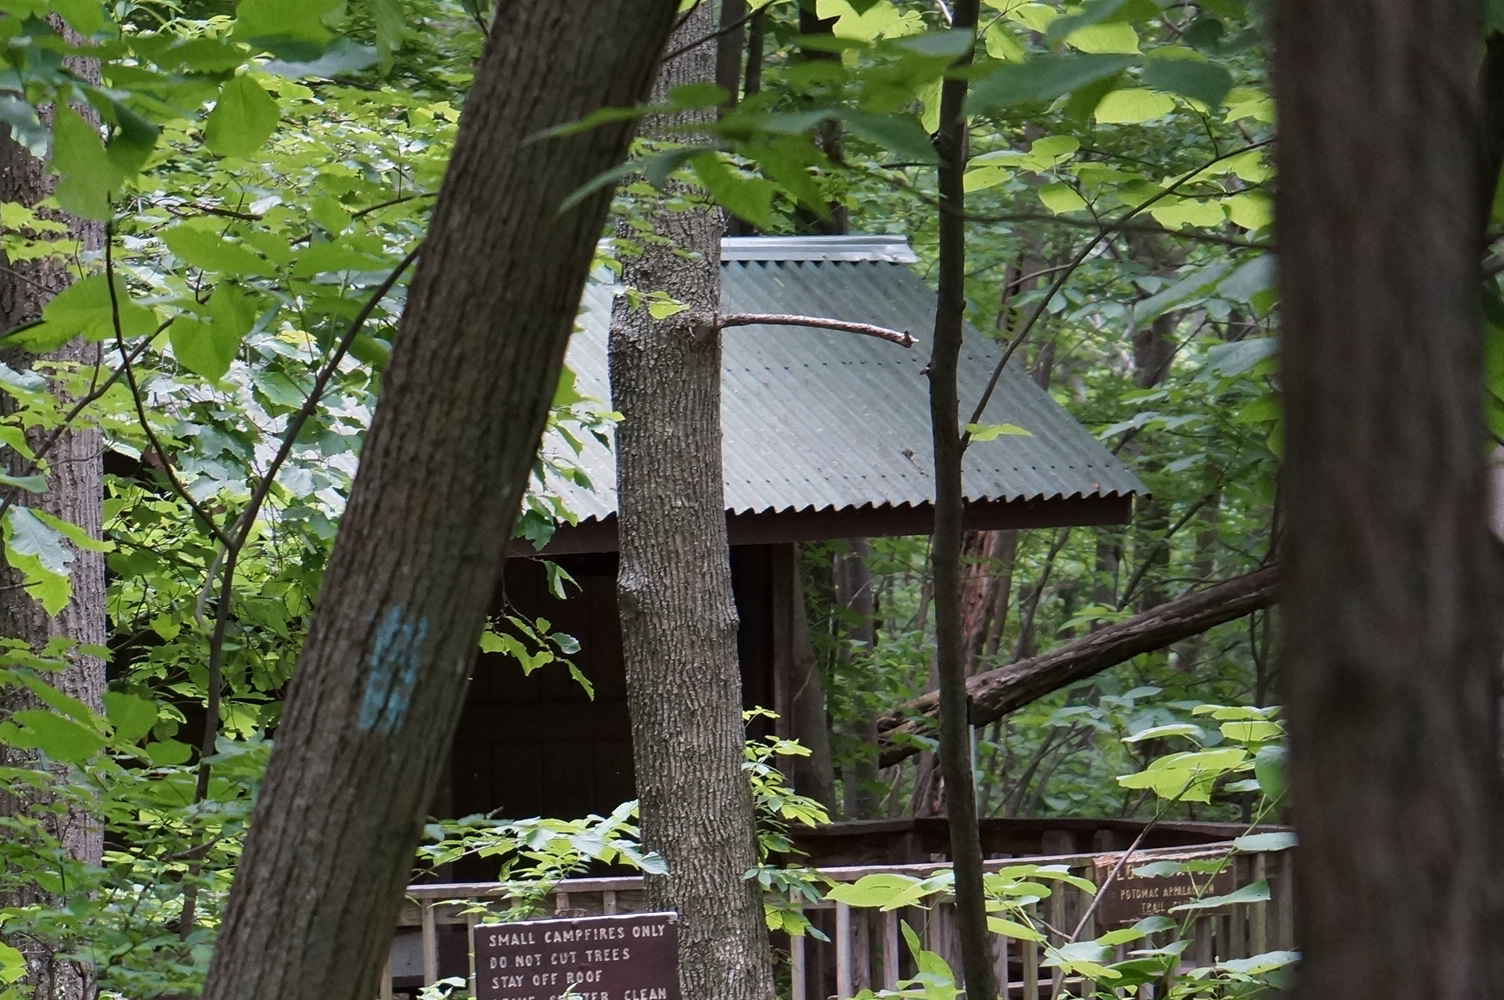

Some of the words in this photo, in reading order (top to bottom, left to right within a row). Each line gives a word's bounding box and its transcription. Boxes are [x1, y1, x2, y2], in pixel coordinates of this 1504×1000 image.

[1120, 887, 1159, 900] POTOMAC
[489, 932, 535, 947] SMALL
[544, 926, 625, 943] CAMPFIRES
[632, 924, 665, 938] ONLY
[490, 956, 507, 969] DO
[515, 953, 542, 967] NOT
[551, 951, 577, 965] CUT
[585, 947, 630, 962] TREES
[491, 974, 524, 989] STAY
[532, 972, 558, 986] OFF
[566, 969, 602, 984] ROOF
